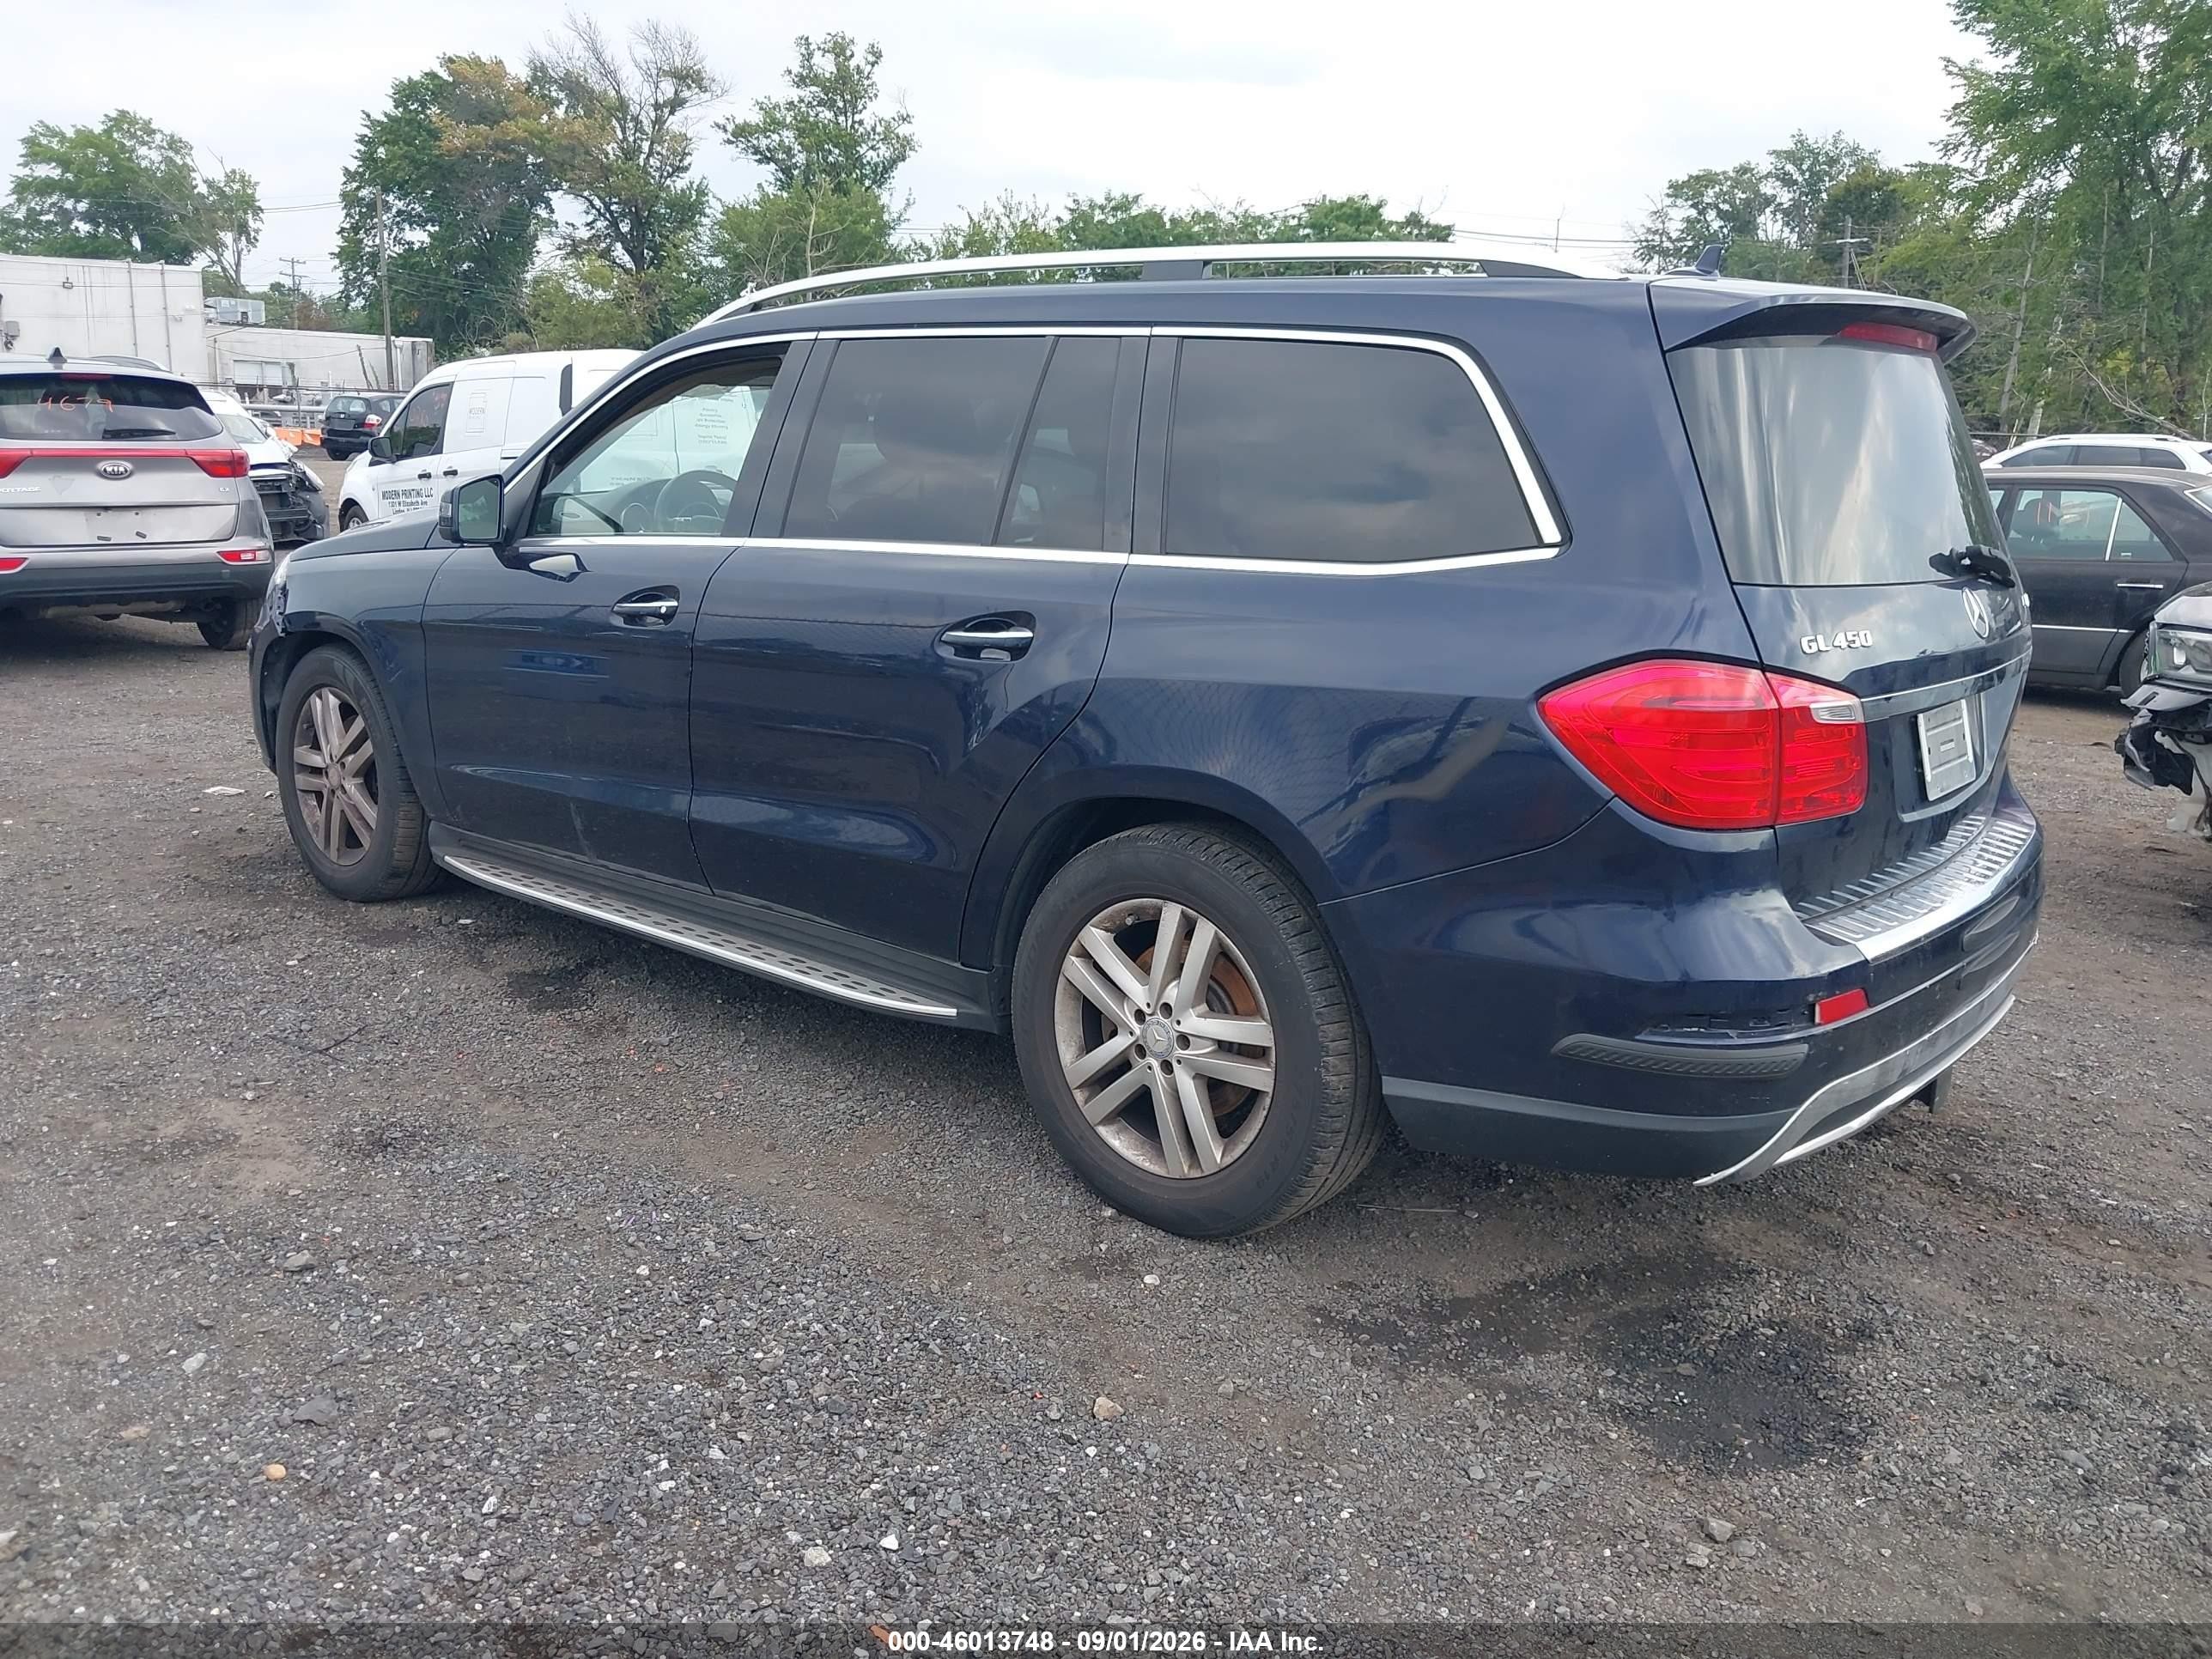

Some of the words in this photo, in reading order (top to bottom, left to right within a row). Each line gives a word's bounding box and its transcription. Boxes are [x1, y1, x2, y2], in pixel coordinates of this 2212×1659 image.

[105, 465, 127, 475] KIA
[381, 489, 401, 501] MODERN
[401, 488, 424, 499] PRINTING
[424, 487, 434, 498] LLC
[1800, 634, 1832, 654] GL
[1832, 629, 1873, 649] 450
